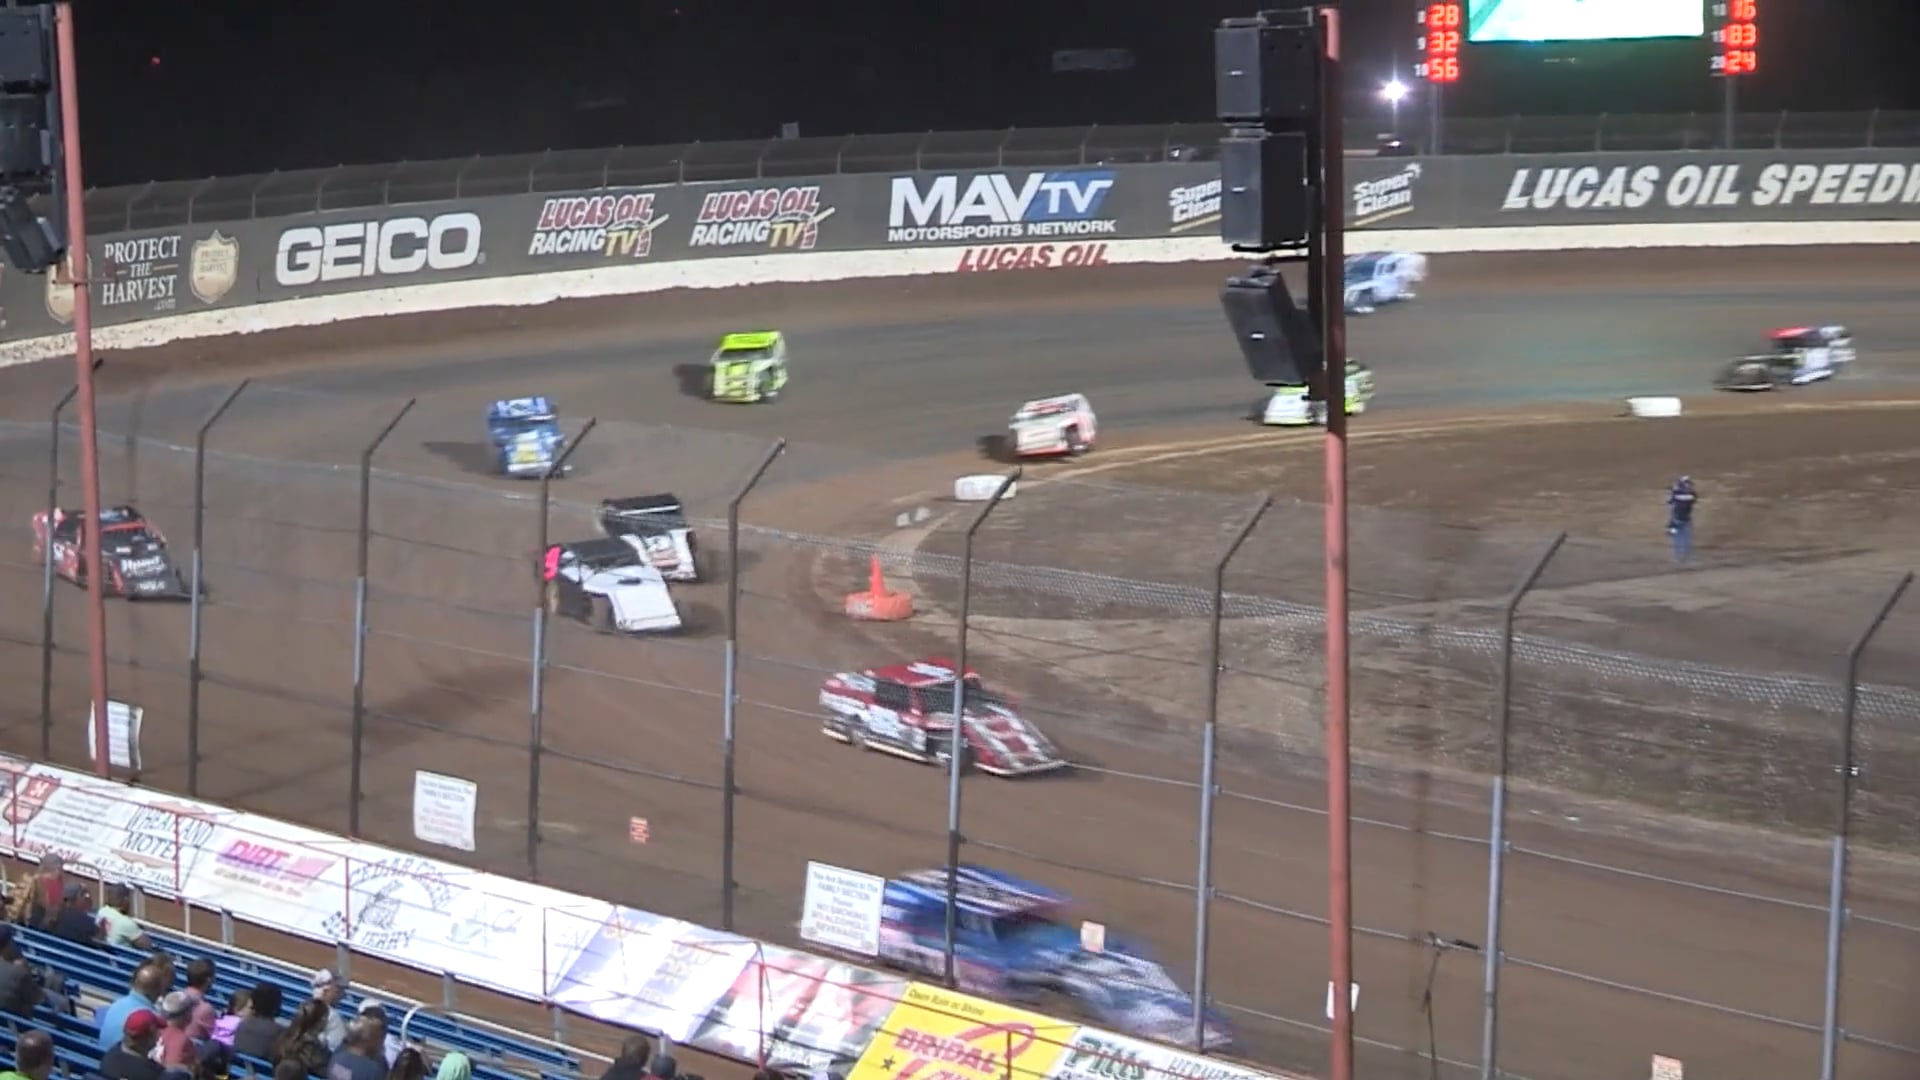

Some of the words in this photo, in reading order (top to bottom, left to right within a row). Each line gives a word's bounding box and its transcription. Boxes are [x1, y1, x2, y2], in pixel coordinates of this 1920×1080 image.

[1429, 4, 1460, 27] 28
[1430, 30, 1460, 53] 32
[1728, 24, 1757, 46] 83
[1414, 64, 1429, 76] 10
[1430, 57, 1459, 80] 56
[1727, 49, 1757, 73] 24
[1353, 173, 1414, 201] Super
[1501, 166, 1660, 208] LUCAS
[1666, 165, 1741, 207] OIL
[537, 195, 615, 230] LUCAS
[613, 193, 655, 222] OIL
[698, 188, 773, 223] LUCAS
[777, 186, 820, 215] OIL
[1356, 189, 1411, 216] Clean
[887, 222, 1025, 243] MOTORSPORTS
[1027, 219, 1118, 237] NETWORK
[104, 236, 182, 264] PROTECT
[275, 212, 482, 287] GEICO
[955, 243, 1055, 273] LUCAS
[1060, 243, 1110, 268] OIL
[129, 263, 154, 278] THE
[102, 275, 178, 306] HARVEST
[895, 1028, 997, 1075] BRIDAL
